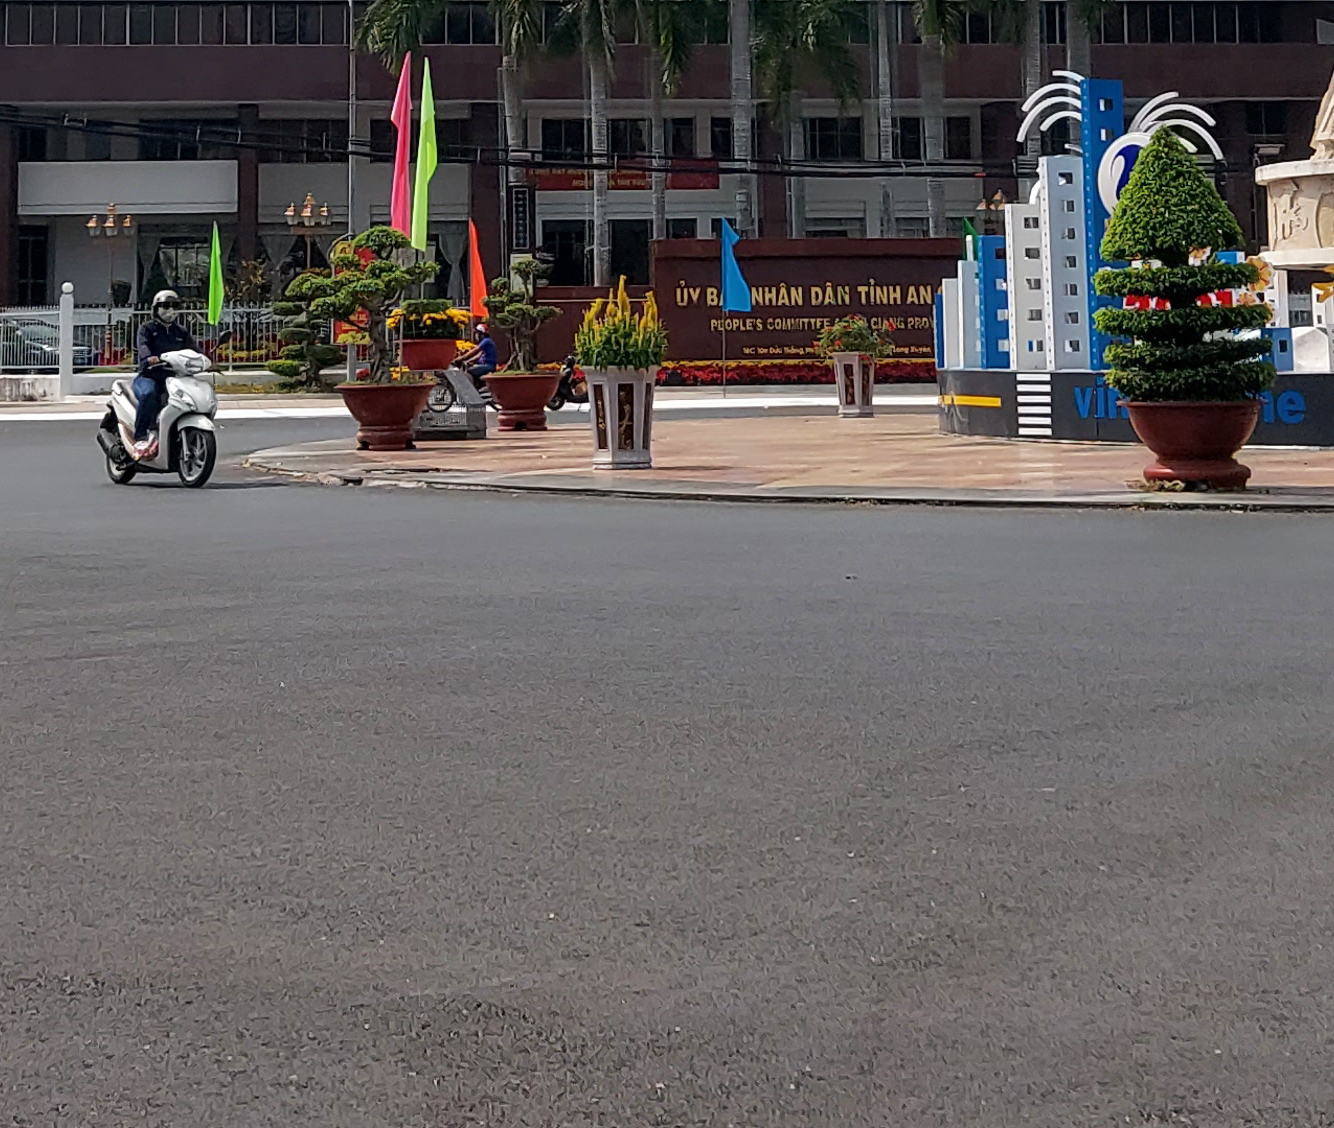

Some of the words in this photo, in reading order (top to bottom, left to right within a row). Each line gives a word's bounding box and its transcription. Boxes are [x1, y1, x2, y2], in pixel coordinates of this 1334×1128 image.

[675, 280, 701, 306] ỦY
[751, 282, 803, 306] NHÂN
[810, 282, 850, 306] DÂN
[857, 278, 902, 305] TỈNH
[906, 285, 932, 304] AN
[711, 319, 763, 331] PEOPLE'S
[767, 318, 831, 330] COMMITTEE
